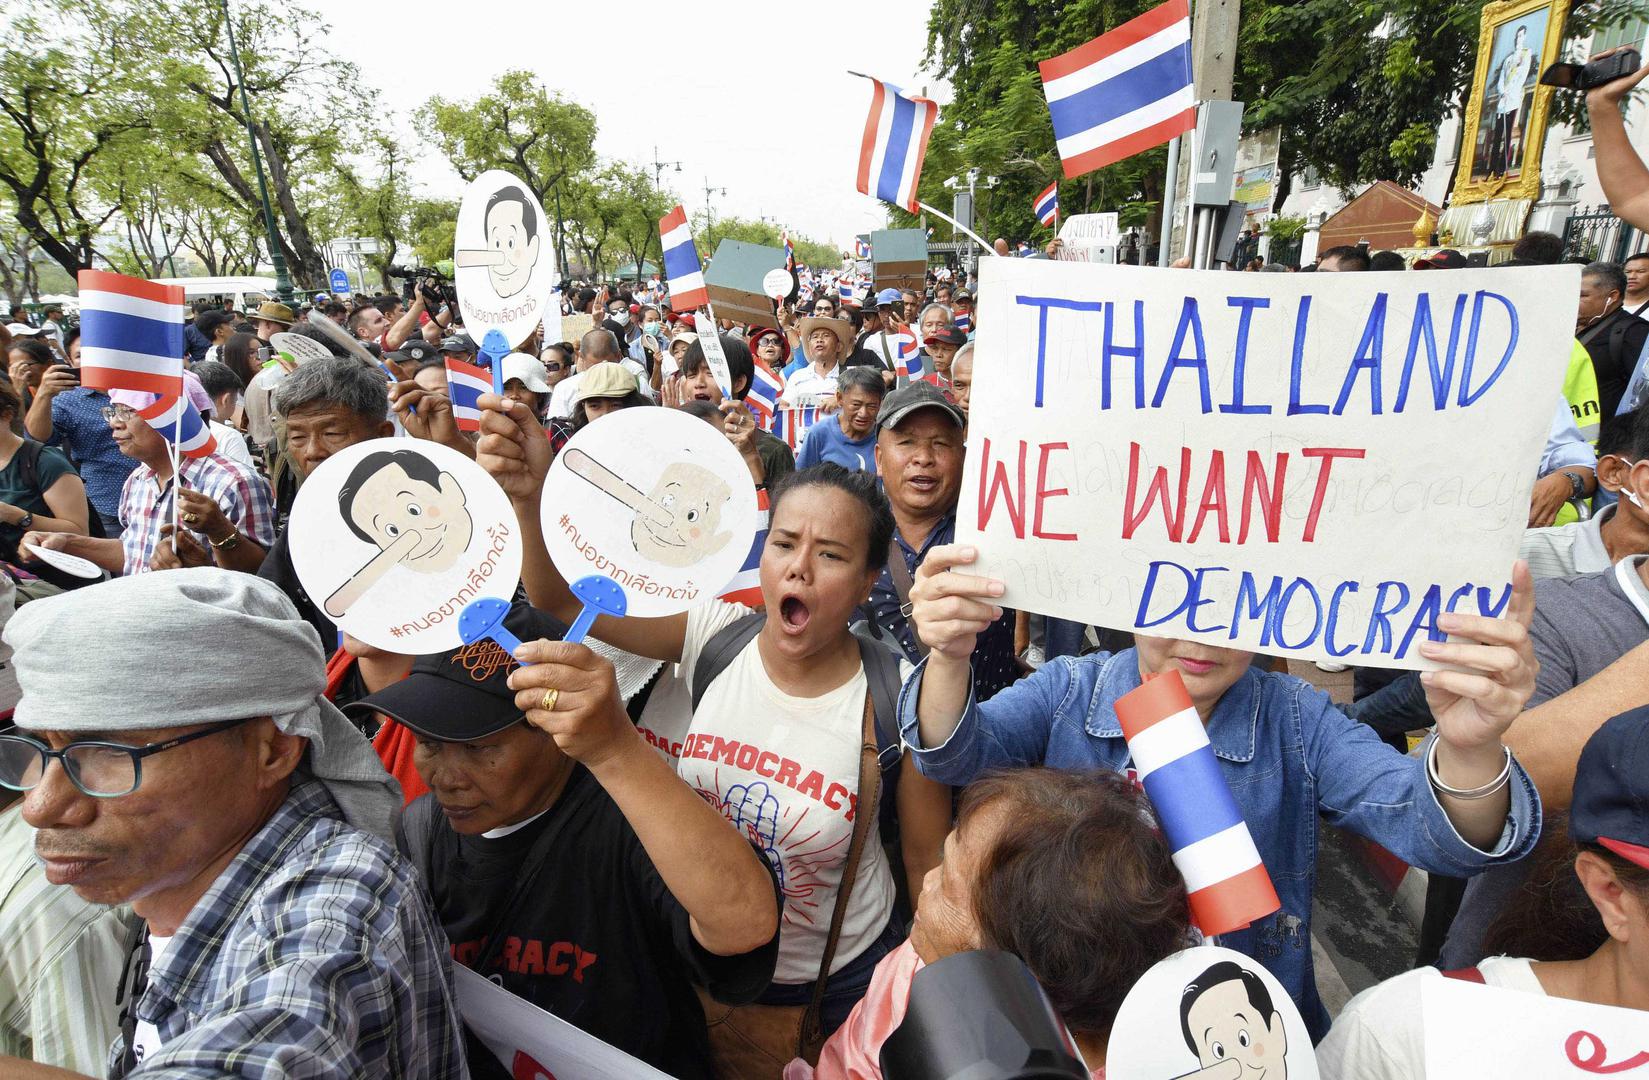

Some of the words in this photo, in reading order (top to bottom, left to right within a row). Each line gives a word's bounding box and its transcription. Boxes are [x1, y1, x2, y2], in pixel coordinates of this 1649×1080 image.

[463, 294, 537, 324] #คนอยากเลือกตั้ง
[1016, 289, 1520, 416] THAILAND
[977, 437, 1079, 542] WE
[1121, 440, 1366, 546] WANT
[390, 522, 510, 638] #คนอยากเลือกตั้ง
[559, 513, 700, 601] #คนอยากเลือกตั้ง
[636, 726, 683, 758] RAC
